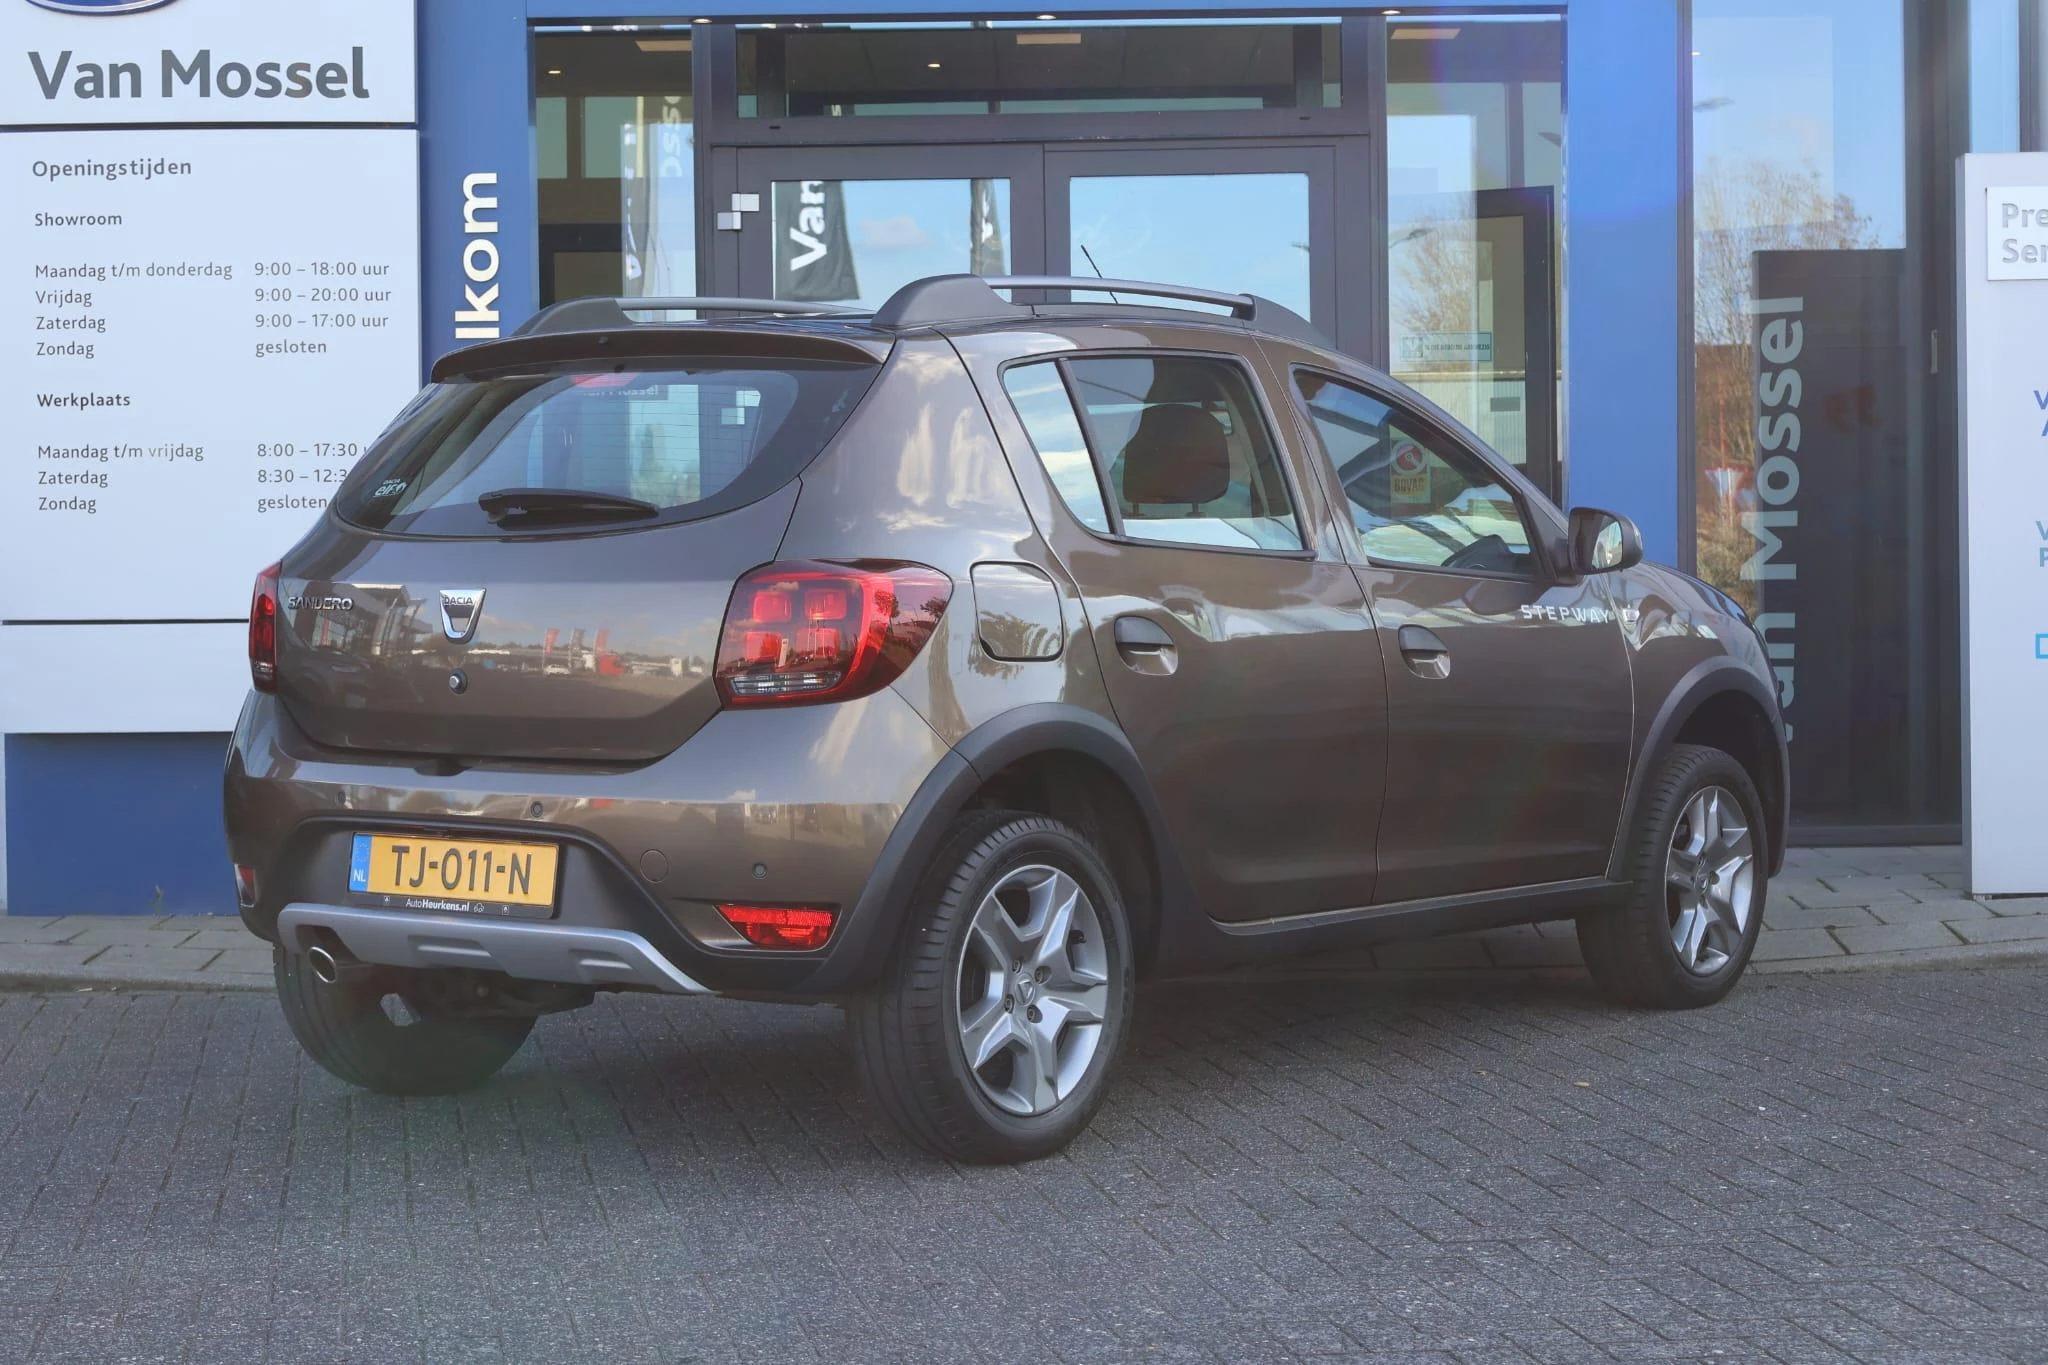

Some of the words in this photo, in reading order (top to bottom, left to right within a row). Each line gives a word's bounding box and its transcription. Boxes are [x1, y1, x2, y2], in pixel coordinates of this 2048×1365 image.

[27, 50, 142, 100] Van
[161, 46, 371, 99] Mossel
[32, 158, 192, 182] Openingstijden
[35, 212, 123, 227] Showroom
[789, 180, 827, 272] Van
[455, 172, 500, 339] lkom
[35, 263, 106, 281] Maandag
[111, 263, 141, 278] t/m
[146, 261, 233, 280] donderdag
[255, 262, 292, 276] 9:00
[311, 262, 357, 276] 18:00
[363, 264, 390, 276] uur
[35, 289, 92, 308] Vrijdag
[255, 288, 292, 302] 9:00
[311, 288, 359, 302] 20:00
[365, 290, 392, 302] uur
[36, 315, 106, 333] Zaterdag
[255, 313, 292, 328] 9:00
[312, 313, 357, 328] 17:00
[362, 316, 389, 328] uur
[36, 341, 95, 359] Zondag
[255, 339, 327, 358] gesloten
[37, 392, 131, 411] Werkplaats
[1740, 296, 1804, 580] Mossel
[38, 444, 108, 462] Maandag
[113, 443, 143, 459] t/m
[148, 443, 204, 462] vrijdag
[257, 443, 294, 457] 8:00
[314, 443, 358, 457] 17:30
[38, 470, 108, 488] Zaterdag
[257, 469, 295, 483] 8:30
[314, 469, 348, 483] 12:3
[39, 496, 97, 512] Zondag
[257, 494, 328, 513] gesloten
[287, 597, 353, 610] SANDERO
[443, 596, 473, 606] DACIA
[1520, 604, 1610, 624] STEPWAY
[353, 869, 366, 882] NL
[391, 845, 532, 895] TJ-011-N
[406, 898, 470, 912] AutoHeurkens.nl
